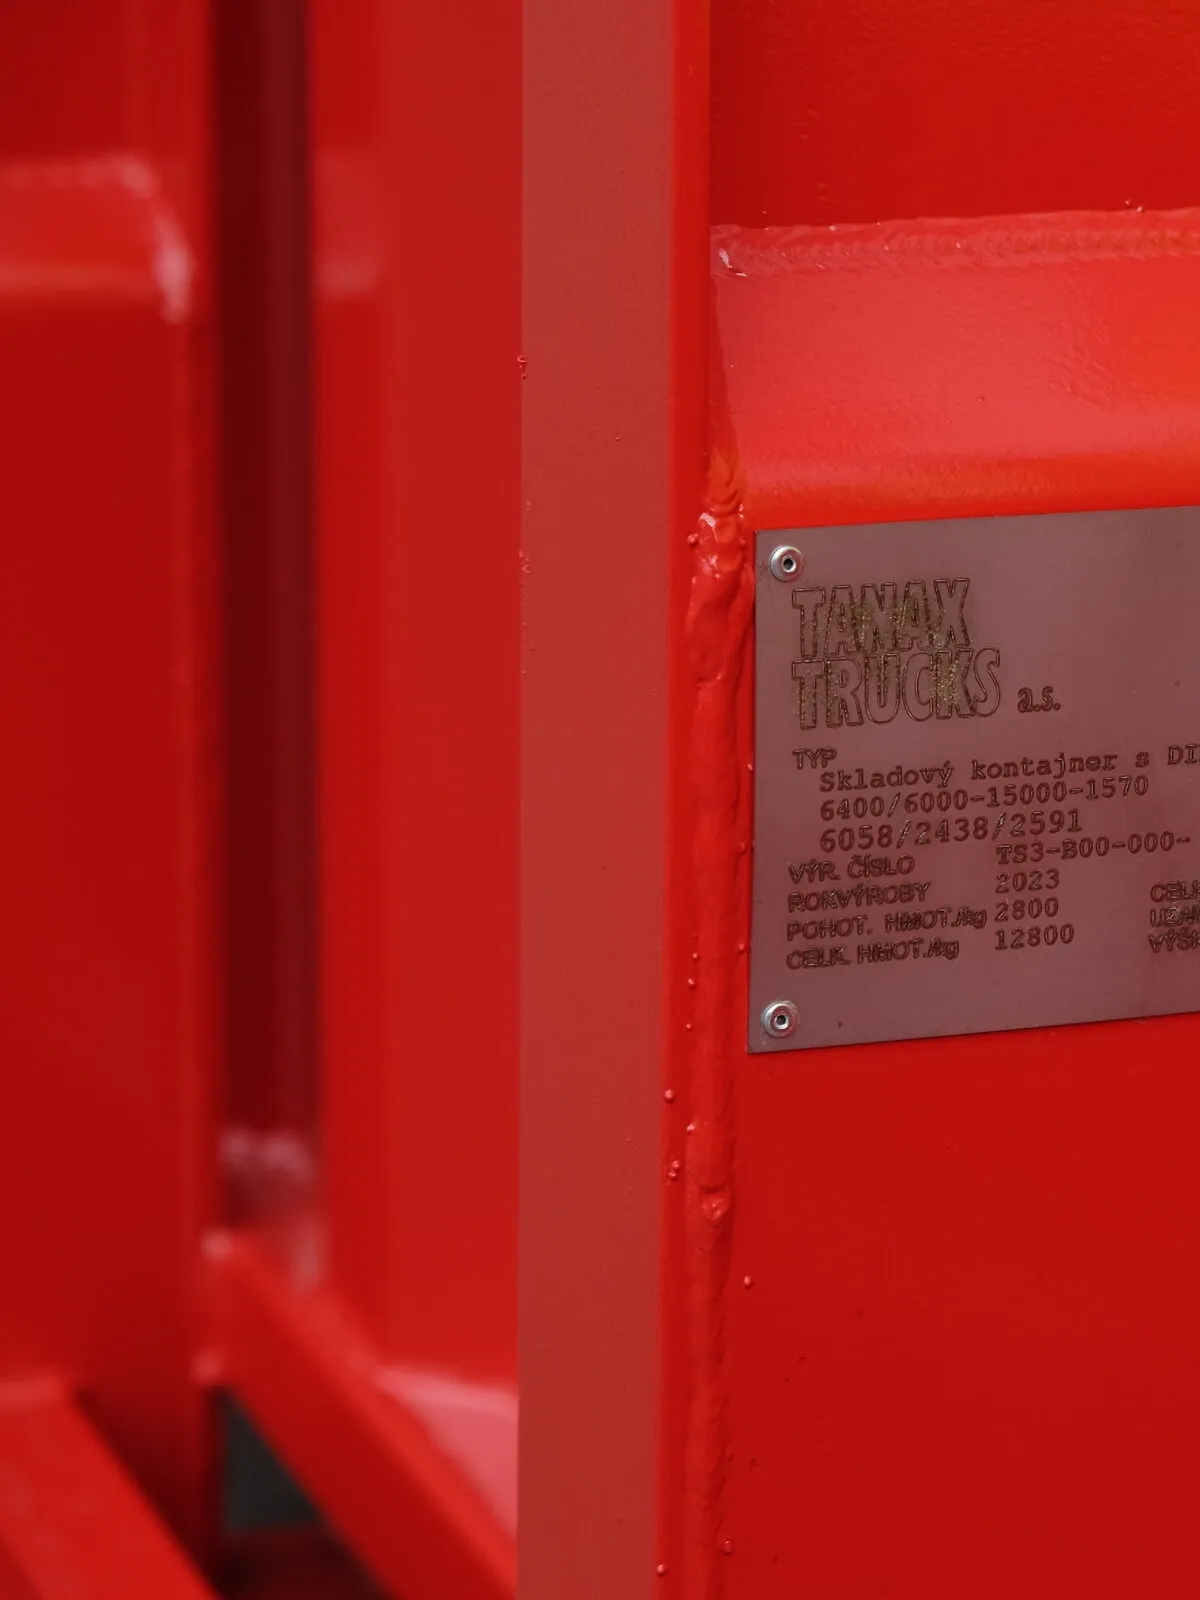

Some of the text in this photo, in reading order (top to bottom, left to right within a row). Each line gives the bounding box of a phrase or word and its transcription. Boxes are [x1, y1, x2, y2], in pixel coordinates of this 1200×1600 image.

[791, 578, 970, 658] TANAX
[791, 648, 1062, 730] TRUCKS a.s.
[792, 748, 837, 770] TYP
[819, 760, 954, 792] Skladový
[971, 752, 1119, 780] kontajner
[1135, 751, 1150, 768] s
[820, 774, 1149, 821] 6400/6000-15000-1570
[820, 808, 1082, 853] 6058/2438/2591
[788, 859, 841, 884] VÝR.
[847, 853, 915, 879] ČÍSLO
[995, 867, 1060, 894] 2023
[786, 914, 874, 942] POHOT.
[994, 897, 1059, 923] 2800
[994, 923, 1075, 951] 12800
